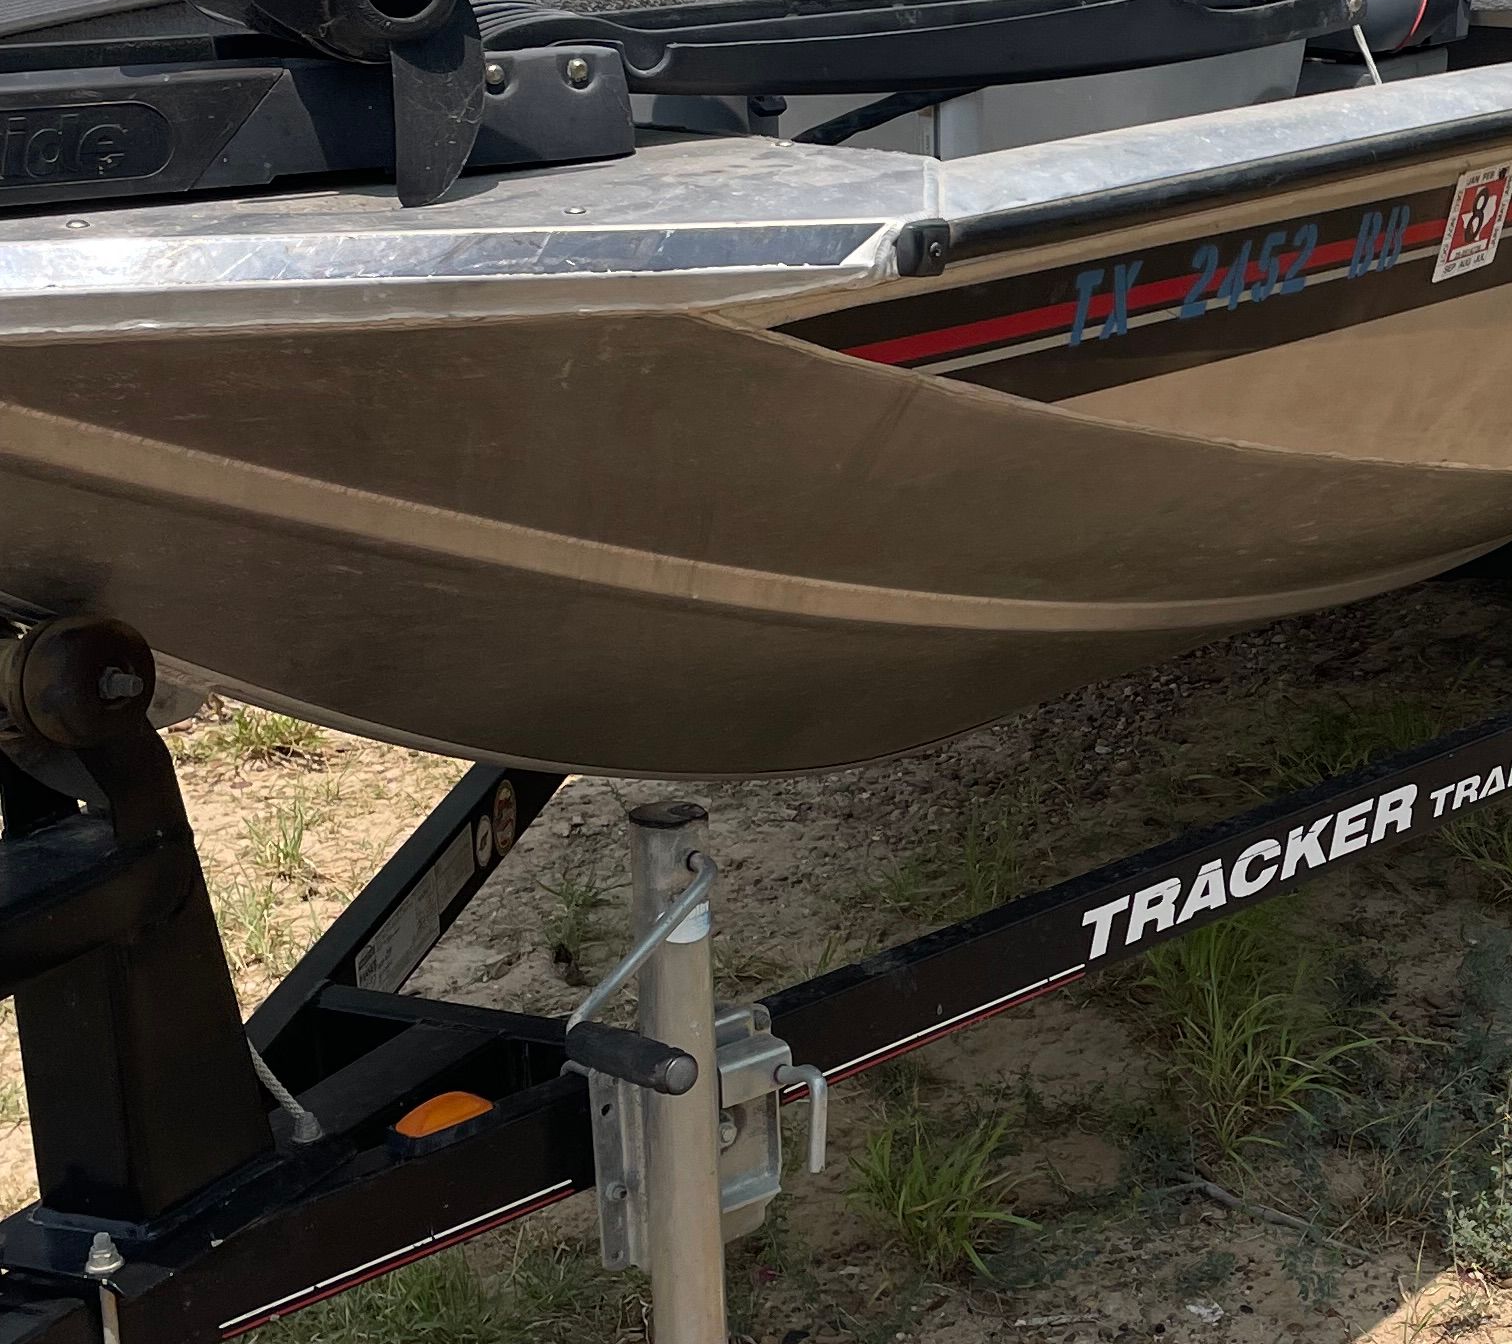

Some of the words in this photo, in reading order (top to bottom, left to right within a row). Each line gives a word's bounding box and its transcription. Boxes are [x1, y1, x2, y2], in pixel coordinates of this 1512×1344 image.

[1464, 186, 1490, 243] 8
[1069, 260, 1144, 346] TX
[1178, 223, 1319, 320] 2452
[1081, 783, 1418, 961] TRACKER
